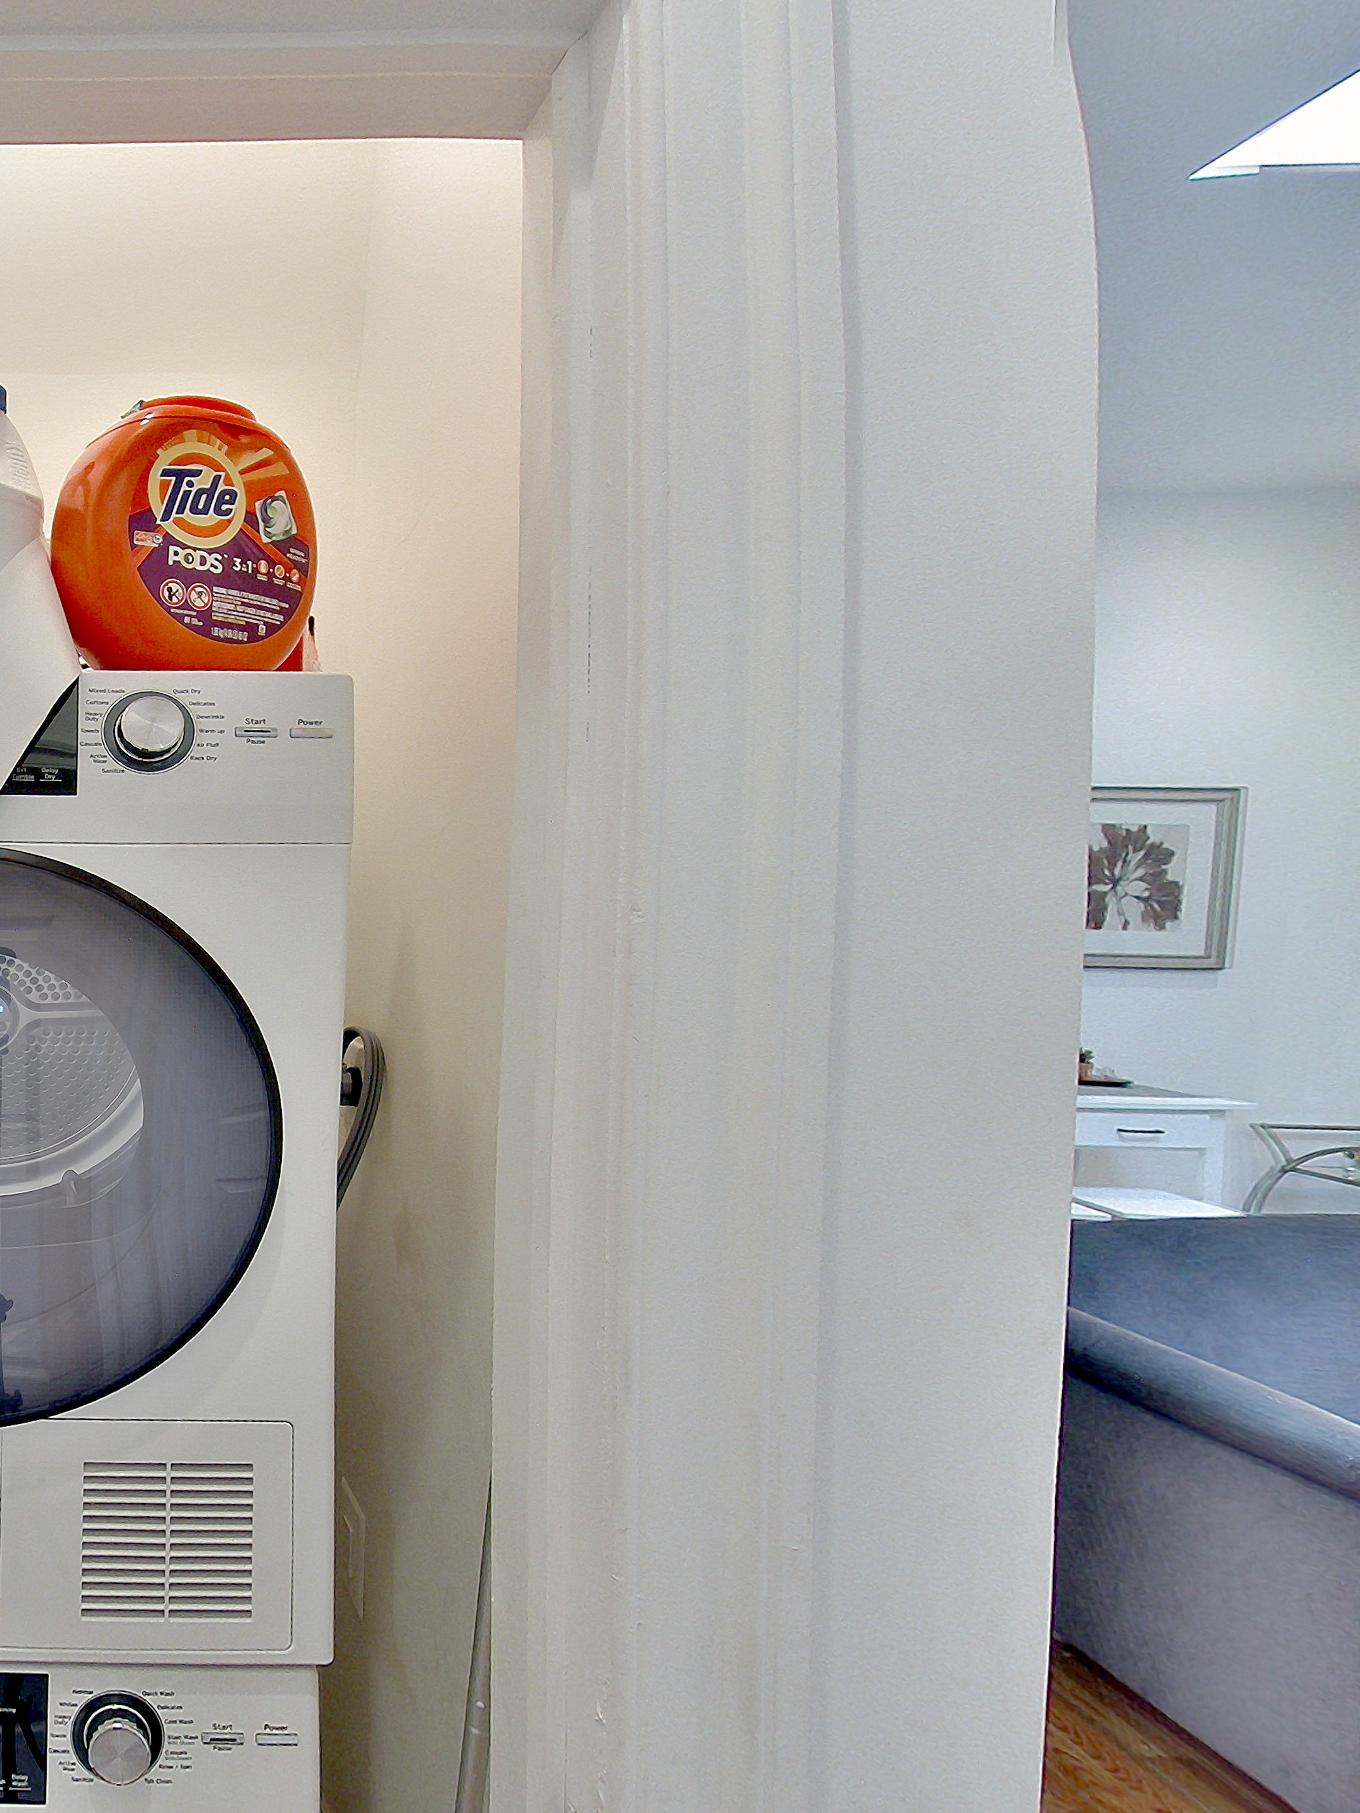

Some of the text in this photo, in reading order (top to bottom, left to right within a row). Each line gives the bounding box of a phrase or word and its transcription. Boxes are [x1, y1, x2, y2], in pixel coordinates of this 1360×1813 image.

[158, 466, 239, 523] Tide
[168, 545, 223, 574] PODS
[297, 718, 323, 726] Power
